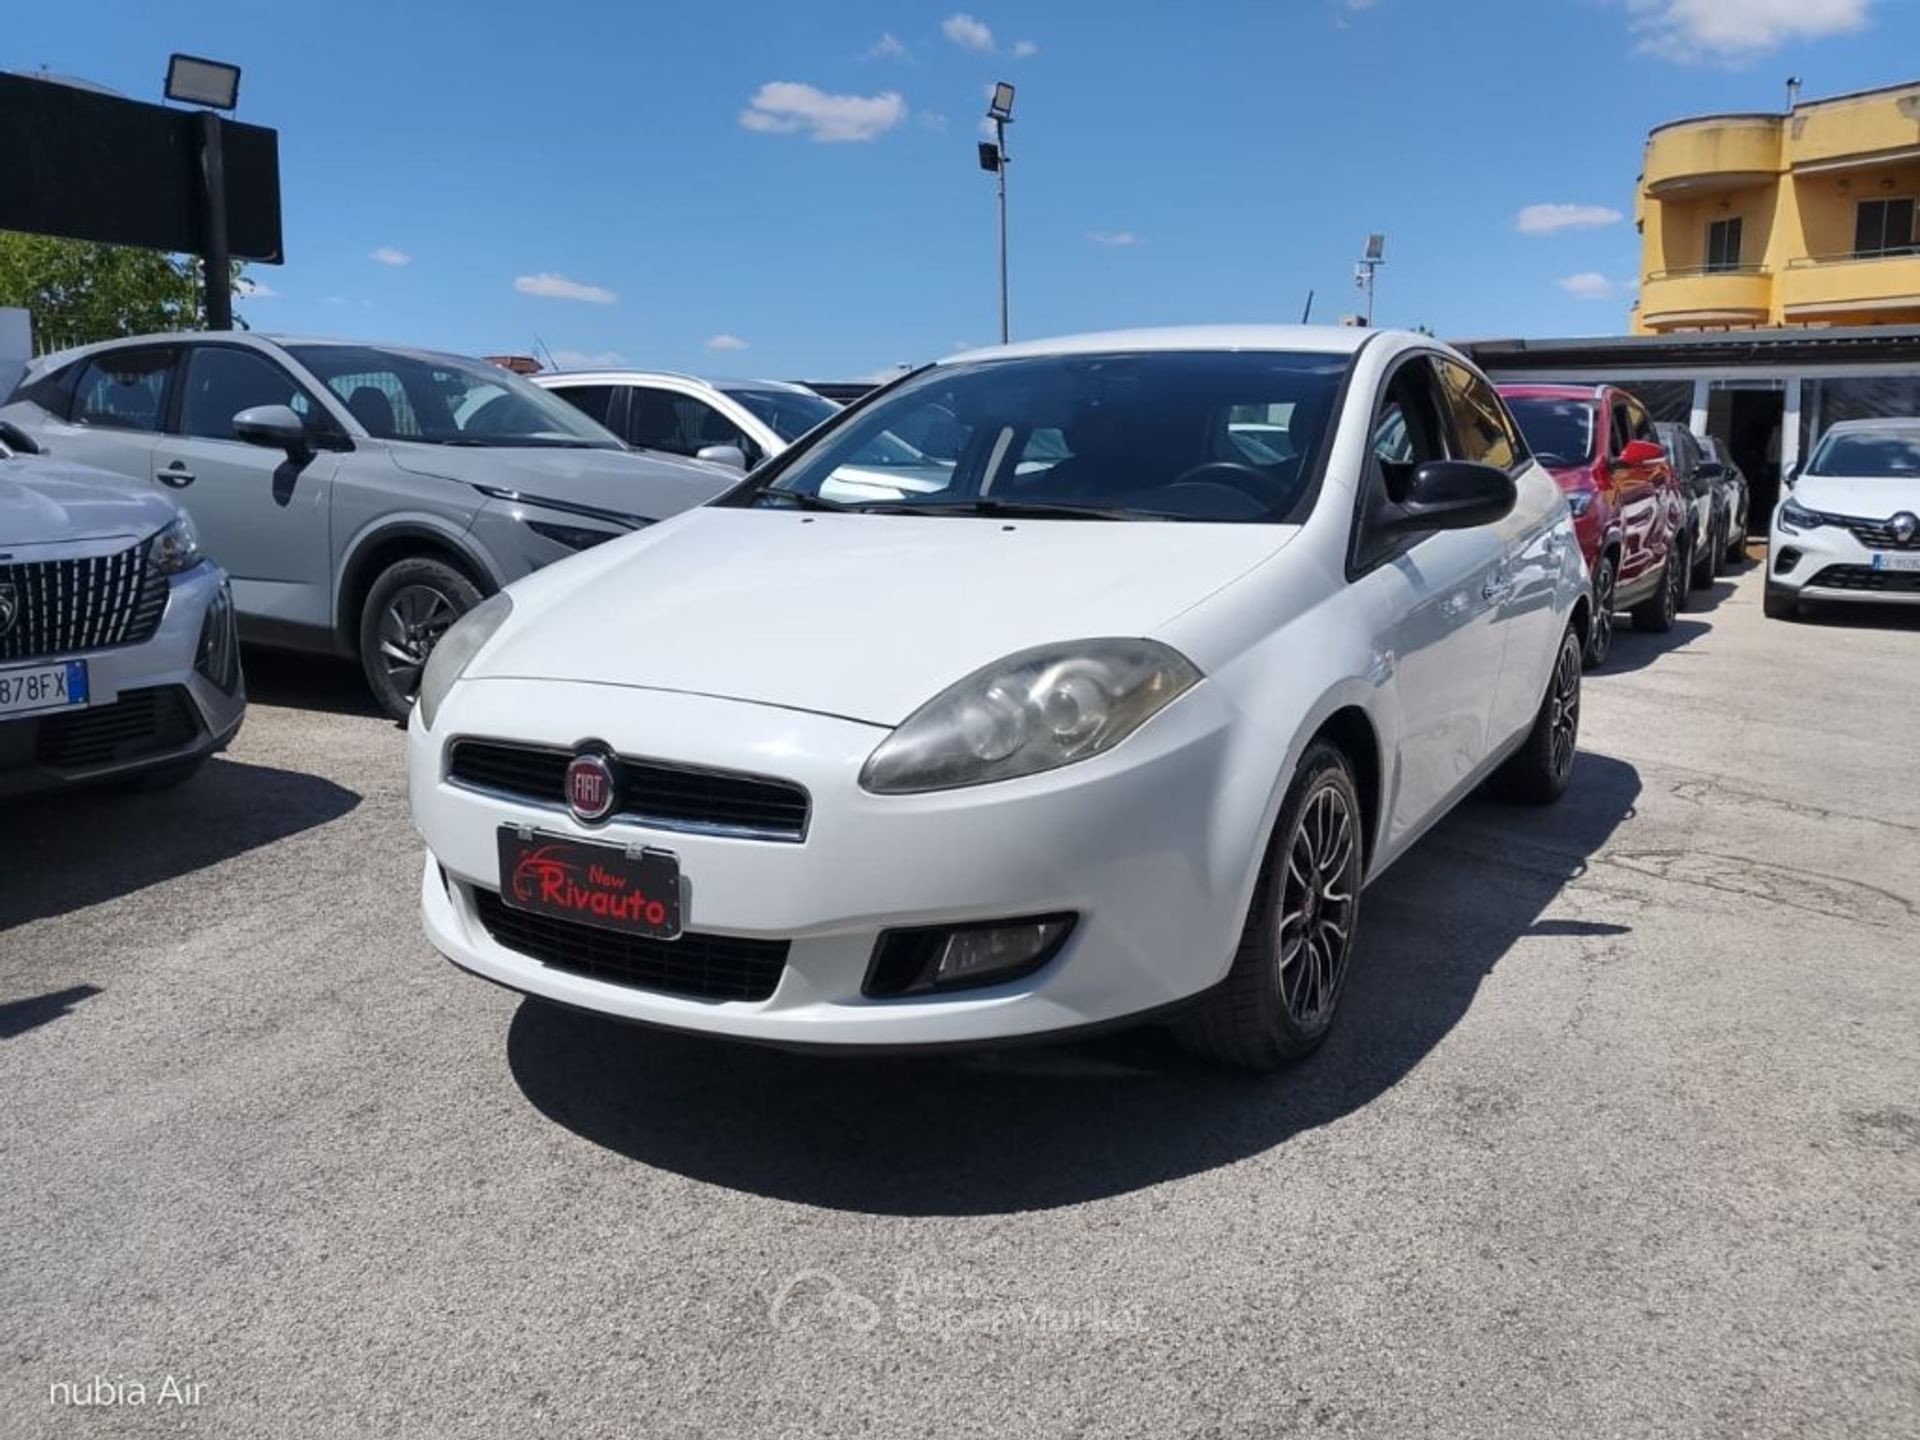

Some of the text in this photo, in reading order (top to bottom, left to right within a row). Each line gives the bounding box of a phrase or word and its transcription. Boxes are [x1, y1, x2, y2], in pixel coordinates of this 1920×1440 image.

[0, 672, 66, 704] 878FX
[575, 773, 603, 801] FIAT
[589, 864, 627, 889] New
[538, 862, 666, 926] Rivauto
